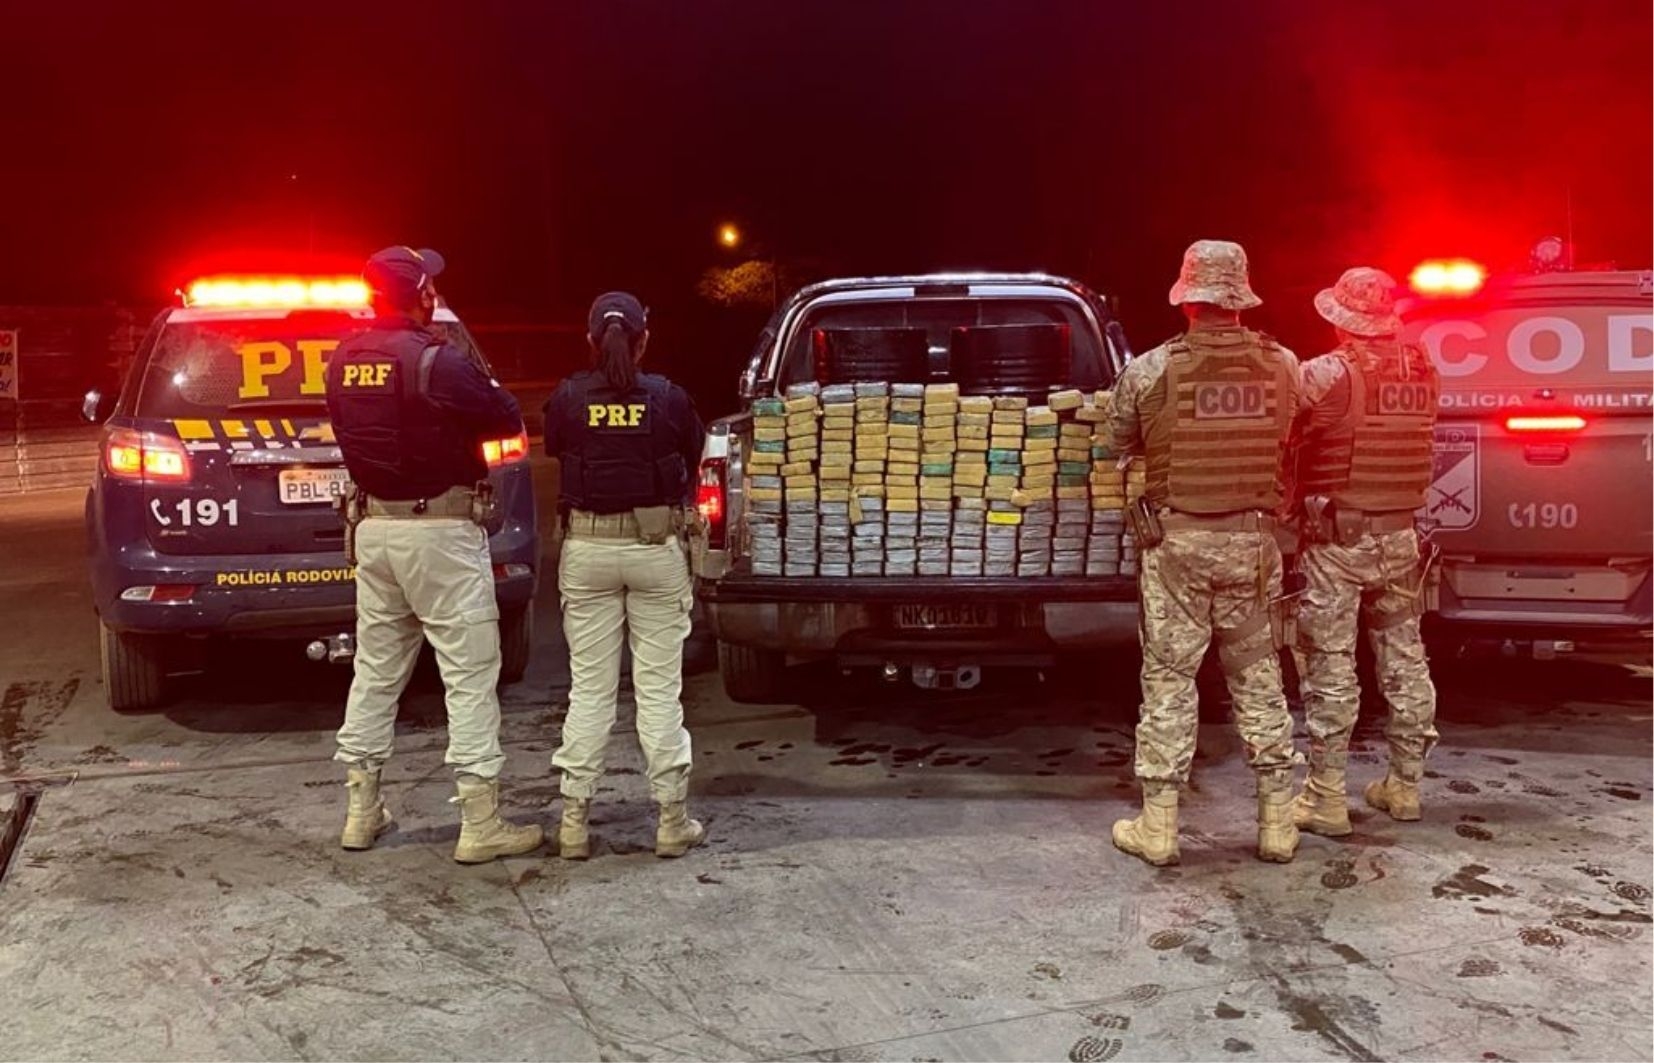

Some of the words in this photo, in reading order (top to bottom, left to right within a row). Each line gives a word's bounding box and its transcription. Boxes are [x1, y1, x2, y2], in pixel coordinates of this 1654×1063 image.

[343, 363, 392, 386] PRF
[1201, 384, 1263, 415] COD
[1381, 384, 1430, 411] COD
[1437, 393, 1524, 407] OLÍCIA
[588, 404, 646, 426] PRF
[176, 498, 239, 526] 191
[1523, 503, 1578, 528] 190
